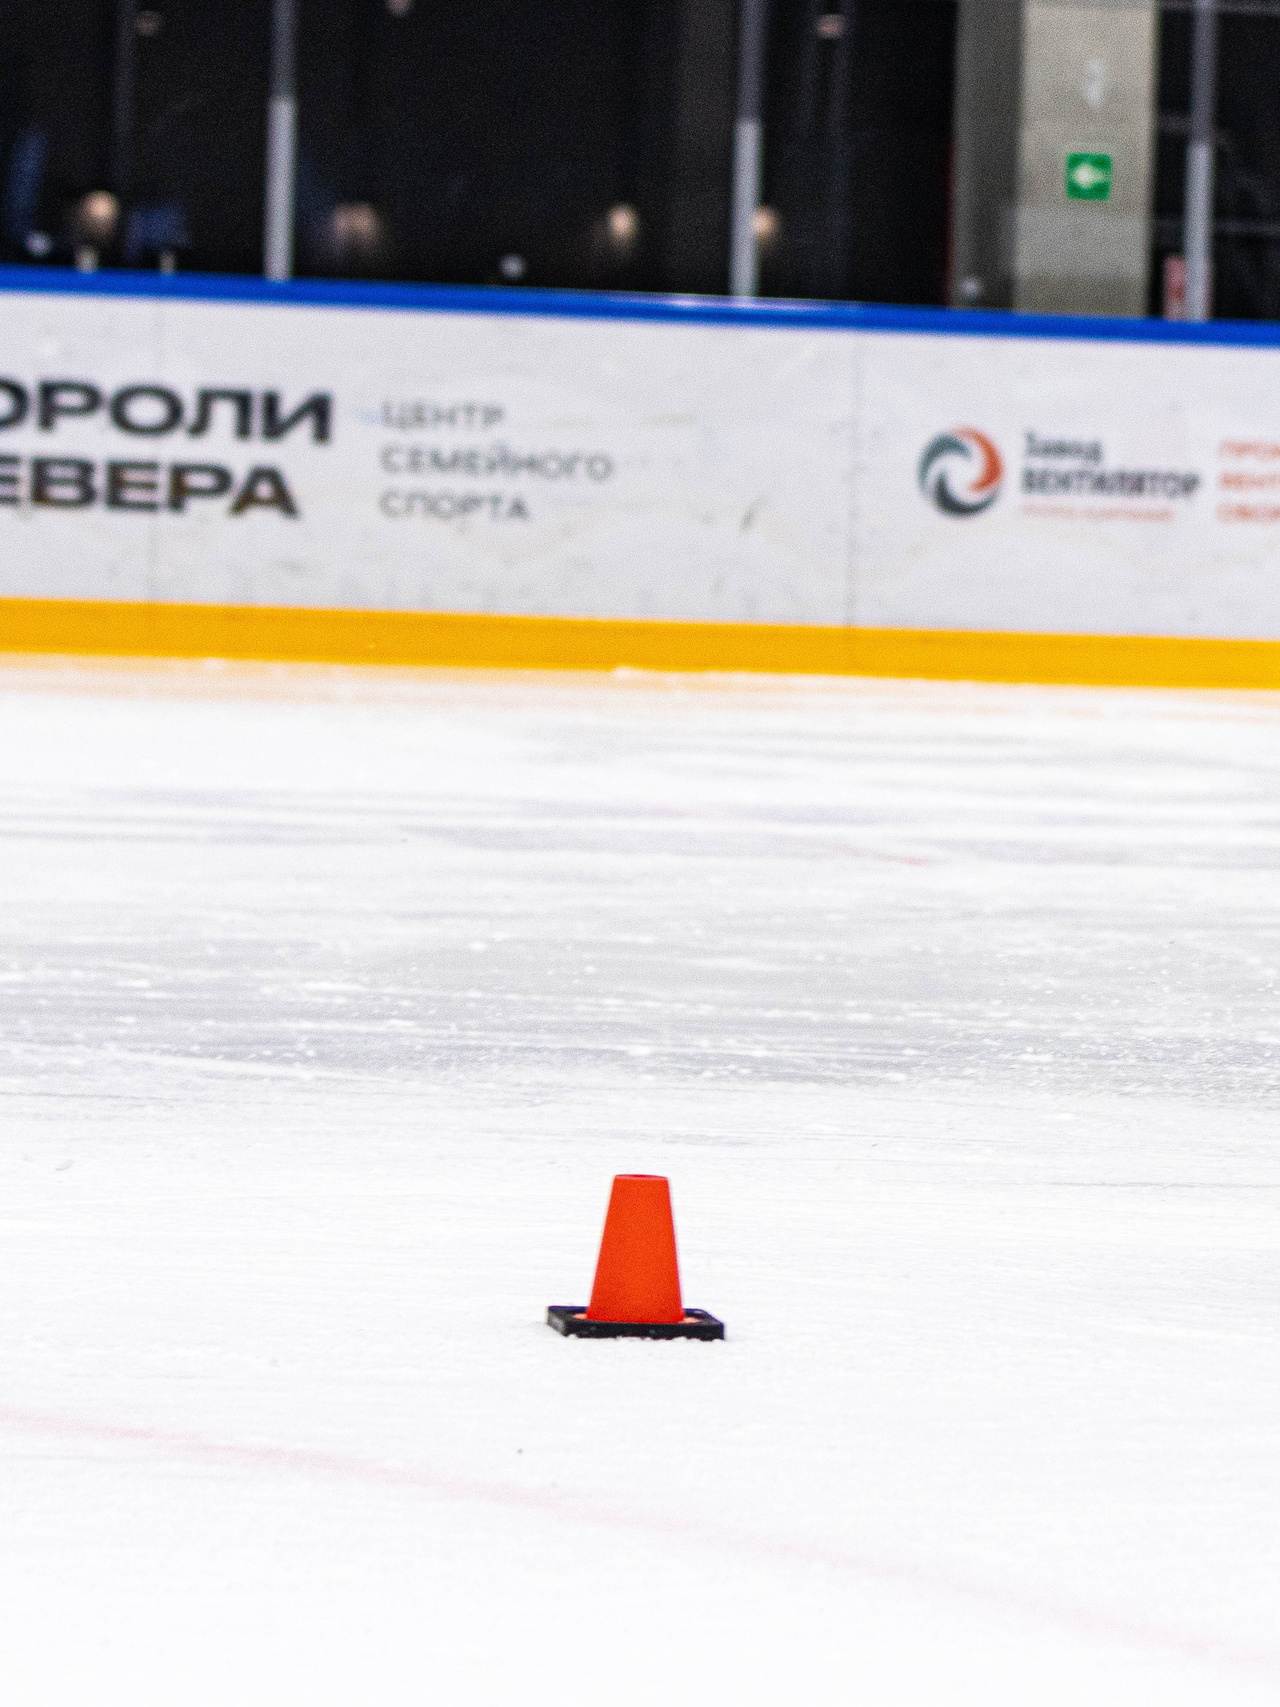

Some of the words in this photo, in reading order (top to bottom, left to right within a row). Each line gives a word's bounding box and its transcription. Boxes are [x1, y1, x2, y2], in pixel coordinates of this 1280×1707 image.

[381, 402, 503, 431] ЦЕНТР
[380, 441, 613, 482] СЕМЕЙНОГО
[380, 489, 530, 522] СПОРТА
